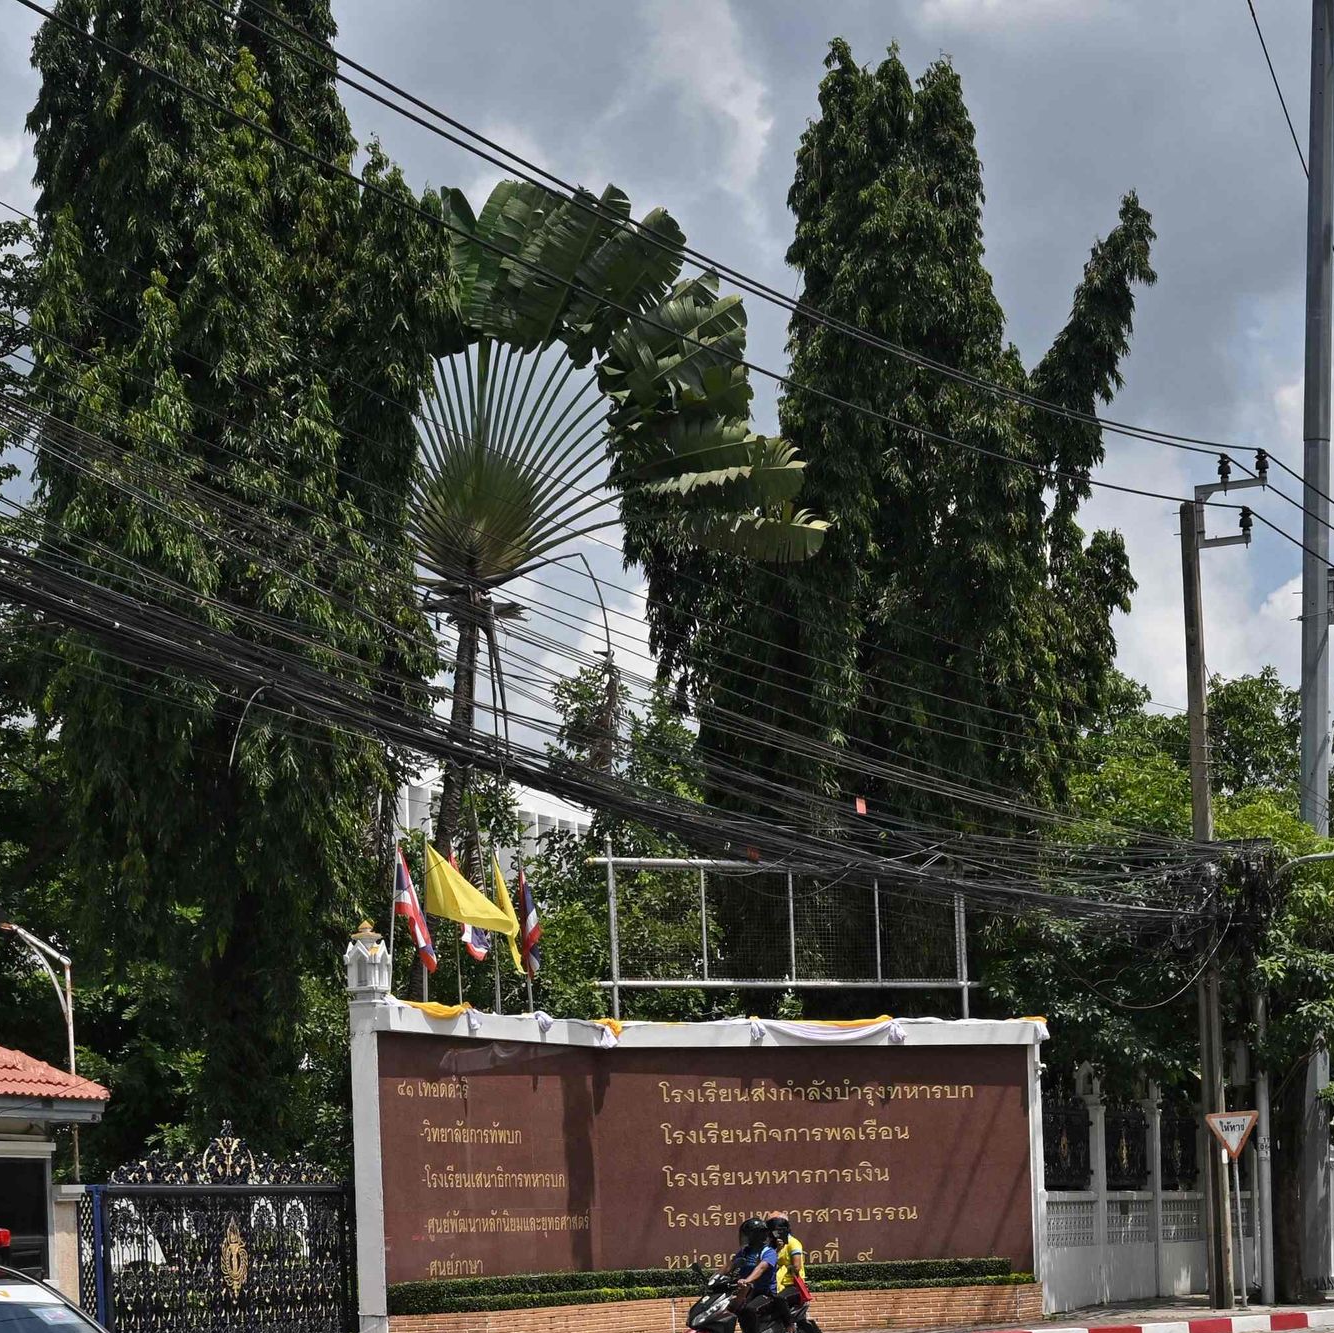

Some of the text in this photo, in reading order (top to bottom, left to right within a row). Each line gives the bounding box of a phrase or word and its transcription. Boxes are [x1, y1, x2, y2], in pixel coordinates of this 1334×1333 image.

[397, 1074, 469, 1099] ๔๑ เทอดดำริ
[658, 1079, 975, 1107] โรงเรียนส่งกำลังบำรุงทหารบก
[660, 1119, 910, 1146] โรงเรียนกิจการพลเรือน
[662, 1160, 891, 1189] โรงเรียนทหารการเงิน
[663, 1203, 919, 1229] โรงเรียนทารสารบรรณ
